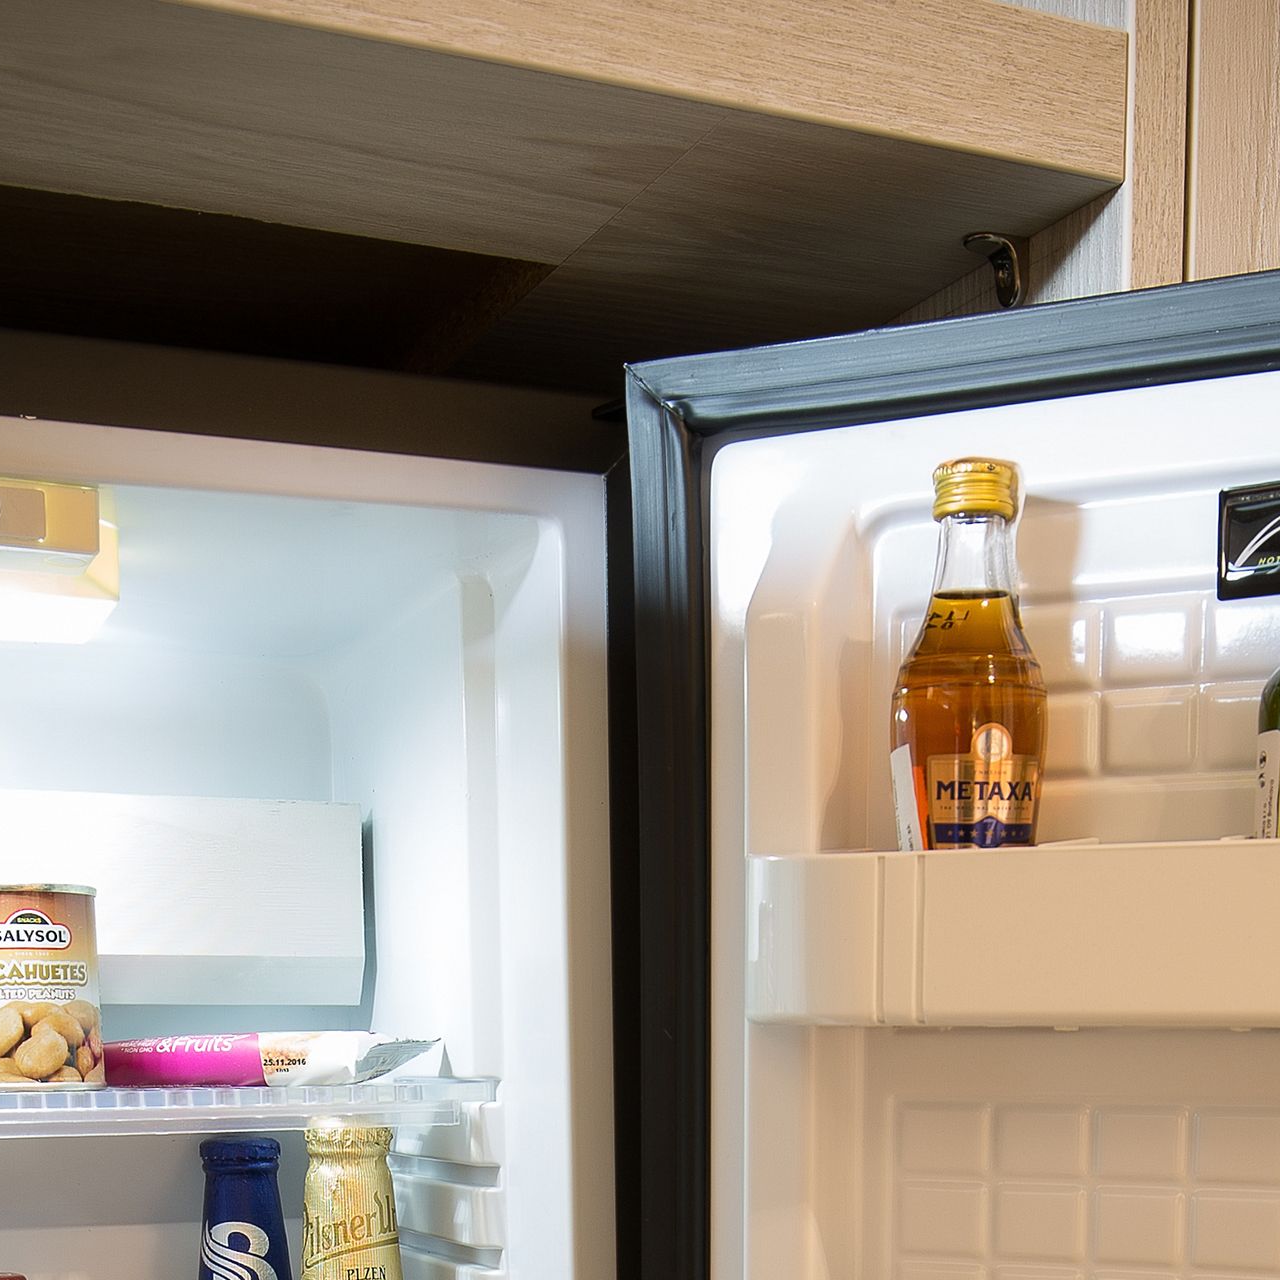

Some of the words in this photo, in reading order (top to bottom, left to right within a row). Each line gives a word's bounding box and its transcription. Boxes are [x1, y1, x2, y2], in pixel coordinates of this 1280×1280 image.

[936, 780, 1033, 801] METAXA
[28, 988, 76, 1000] PEANUTS
[263, 1058, 306, 1067] 25.11.2016
[347, 1264, 386, 1280] PLZEŇ
